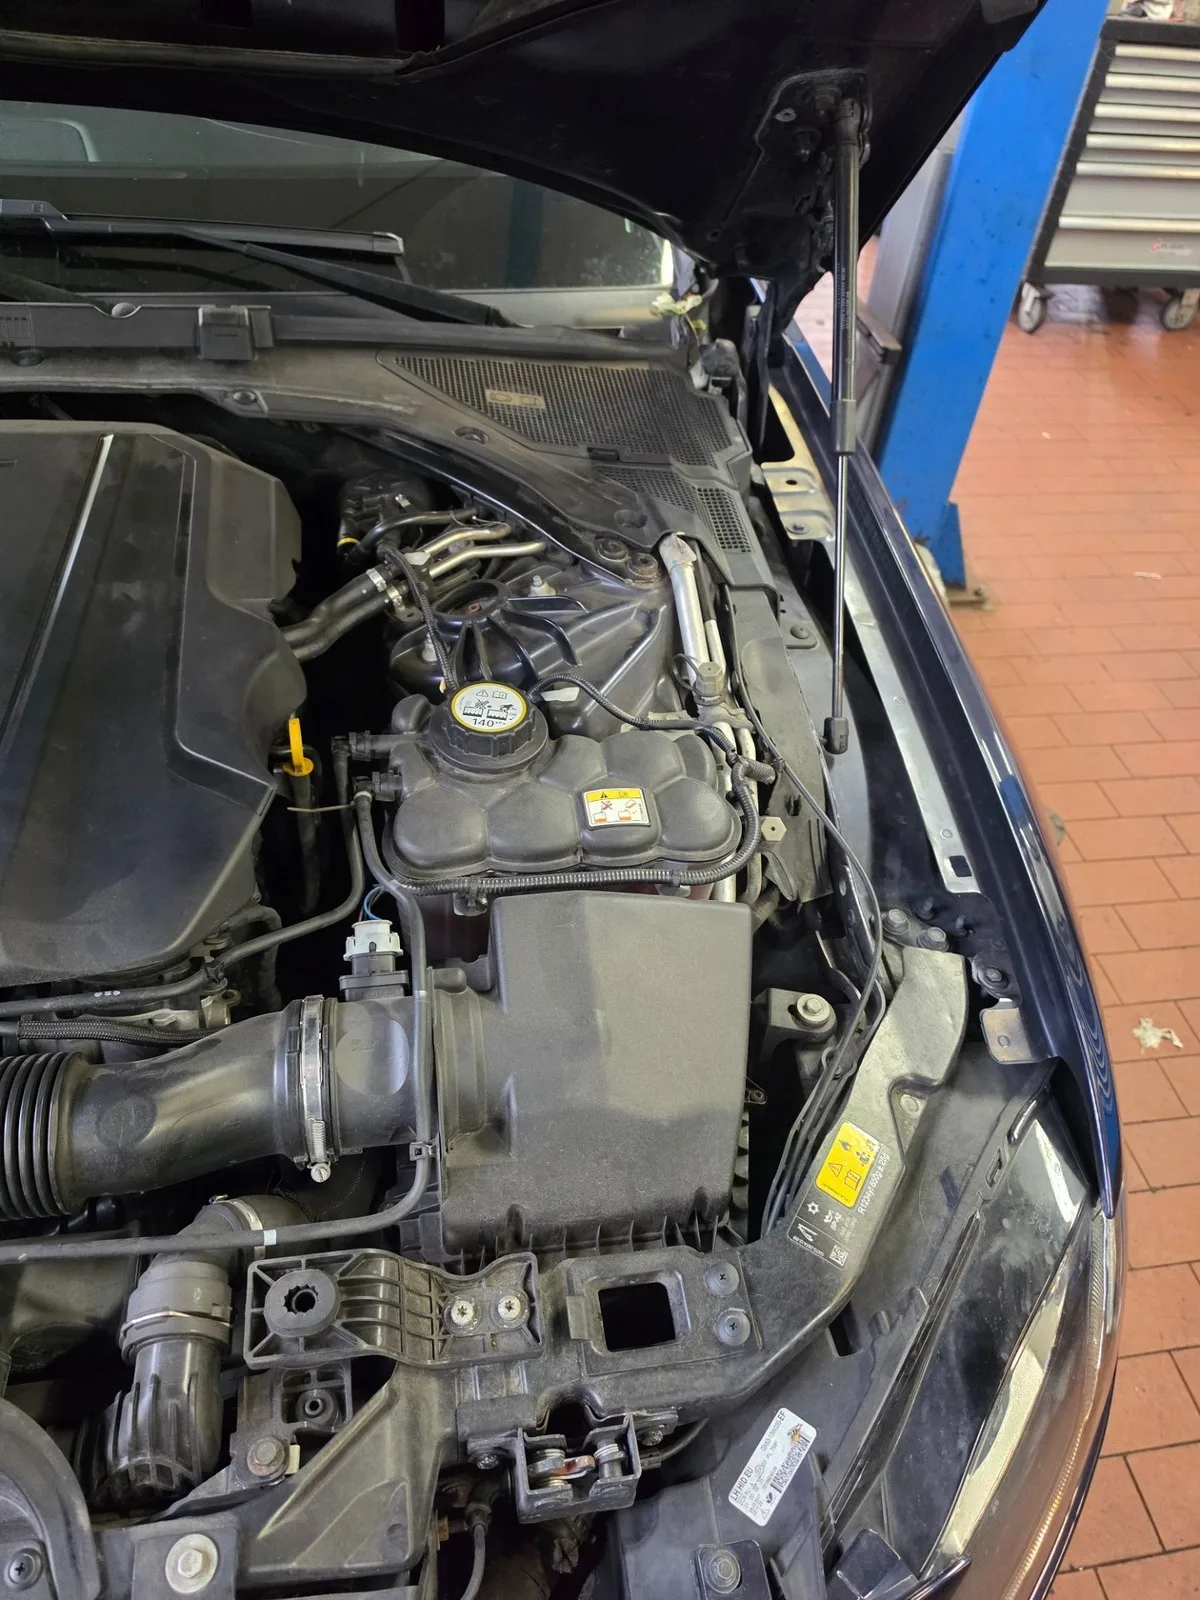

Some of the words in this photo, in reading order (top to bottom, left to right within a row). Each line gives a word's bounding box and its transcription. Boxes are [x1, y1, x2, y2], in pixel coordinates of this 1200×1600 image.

[473, 718, 494, 727] 140
[858, 1186, 875, 1214] R1234yf
[730, 1490, 740, 1501] LH
[738, 1477, 748, 1490] HID
[744, 1467, 754, 1478] EU
